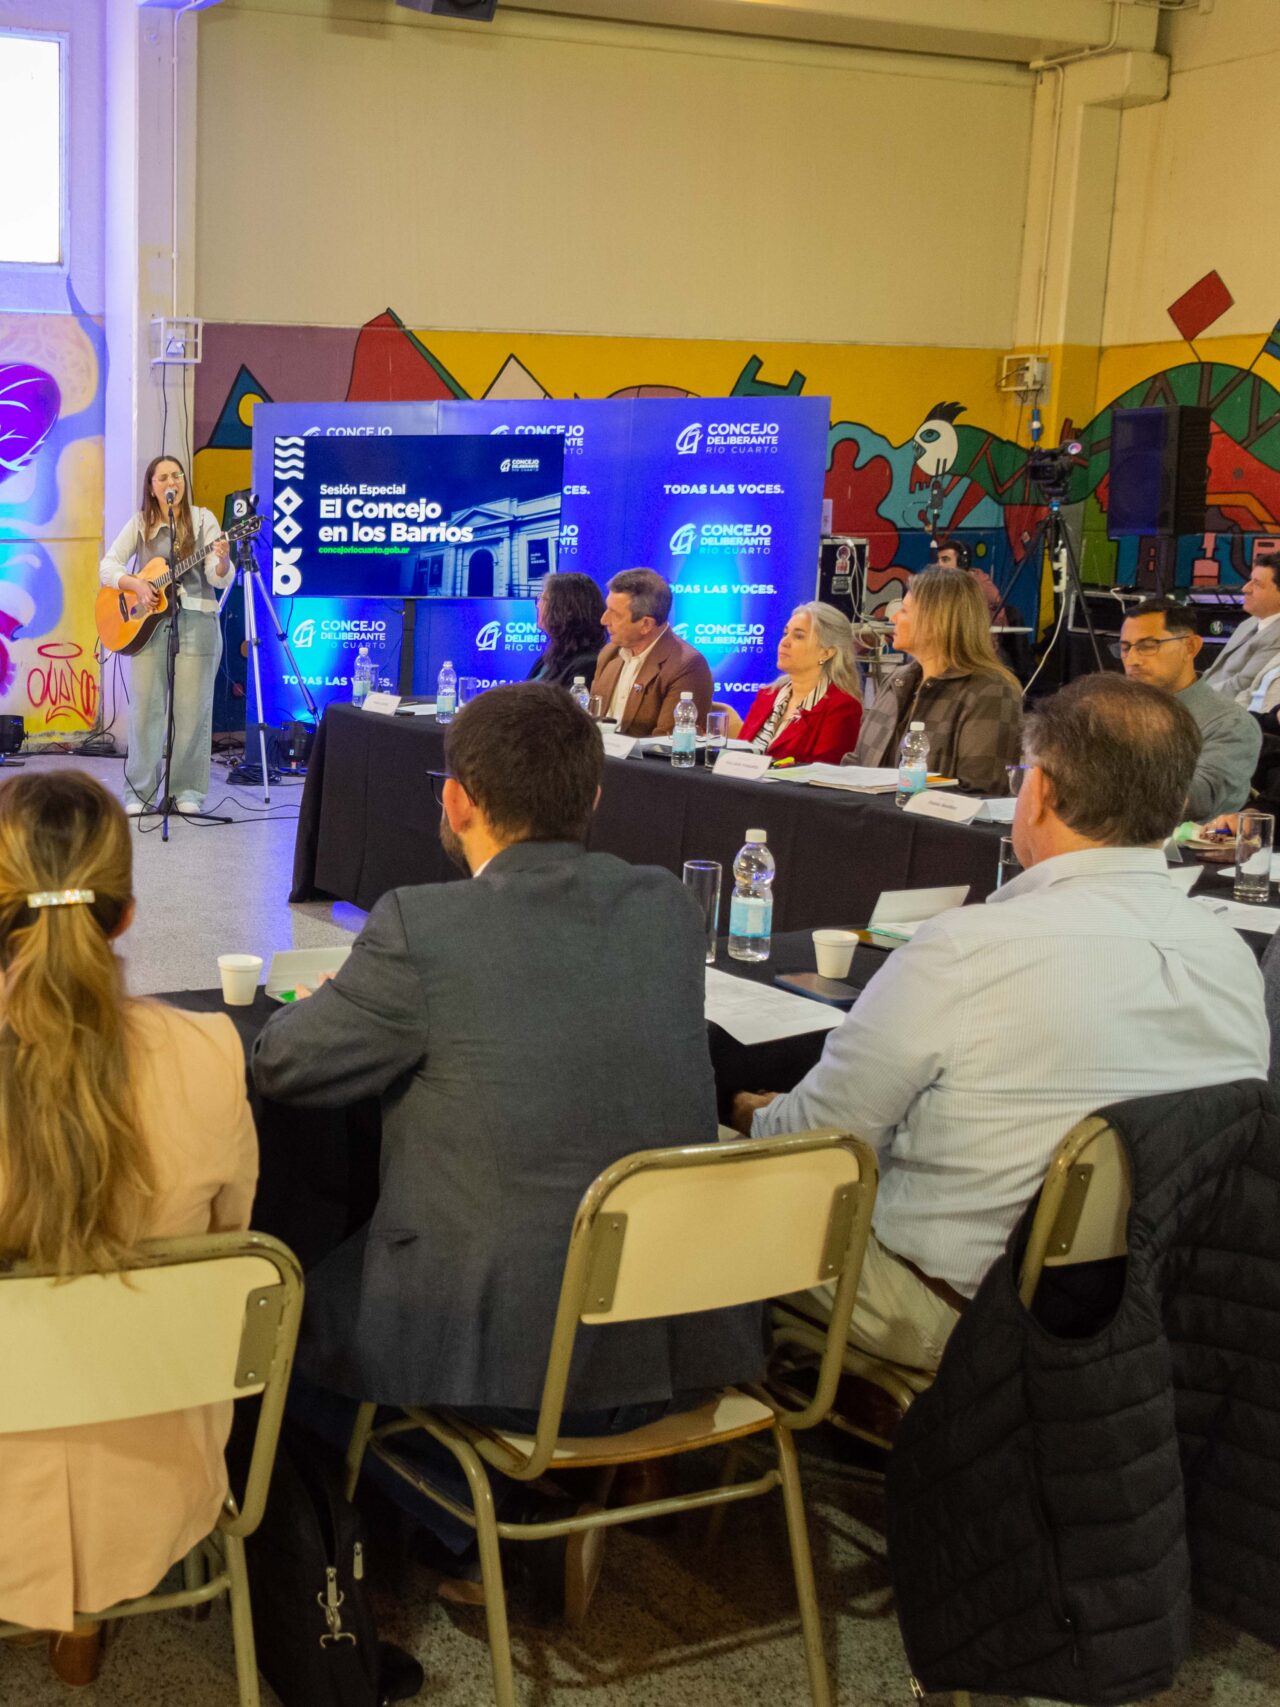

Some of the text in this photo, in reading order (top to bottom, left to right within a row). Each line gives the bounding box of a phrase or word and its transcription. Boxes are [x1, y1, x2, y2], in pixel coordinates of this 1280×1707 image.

[515, 425, 584, 436] CONCEJO
[708, 423, 779, 435] CONCEJO
[707, 436, 778, 445] DELIBERANTE
[731, 446, 778, 454] CUARTO
[320, 484, 406, 497] Sesión Especial
[563, 485, 590, 495] CES.
[664, 484, 784, 494] TODAS LAS VOCES.
[236, 502, 243, 513] 2
[320, 499, 442, 523] El Concejo
[319, 522, 474, 542] en los Barrios
[701, 524, 772, 536] CONCEJO
[700, 537, 771, 546] DELIBERANTE
[724, 547, 771, 555] CUARTO
[704, 584, 728, 594] LAS
[731, 584, 777, 594] VOCES.
[321, 620, 386, 632] CONCEJO
[695, 624, 765, 636] CONCEJO
[321, 632, 386, 641] DELIBERANTE
[505, 634, 547, 643] DELIBER
[694, 636, 764, 645] DELIBERANTE
[342, 641, 386, 650] CUARTO
[325, 676, 348, 686] LAS
